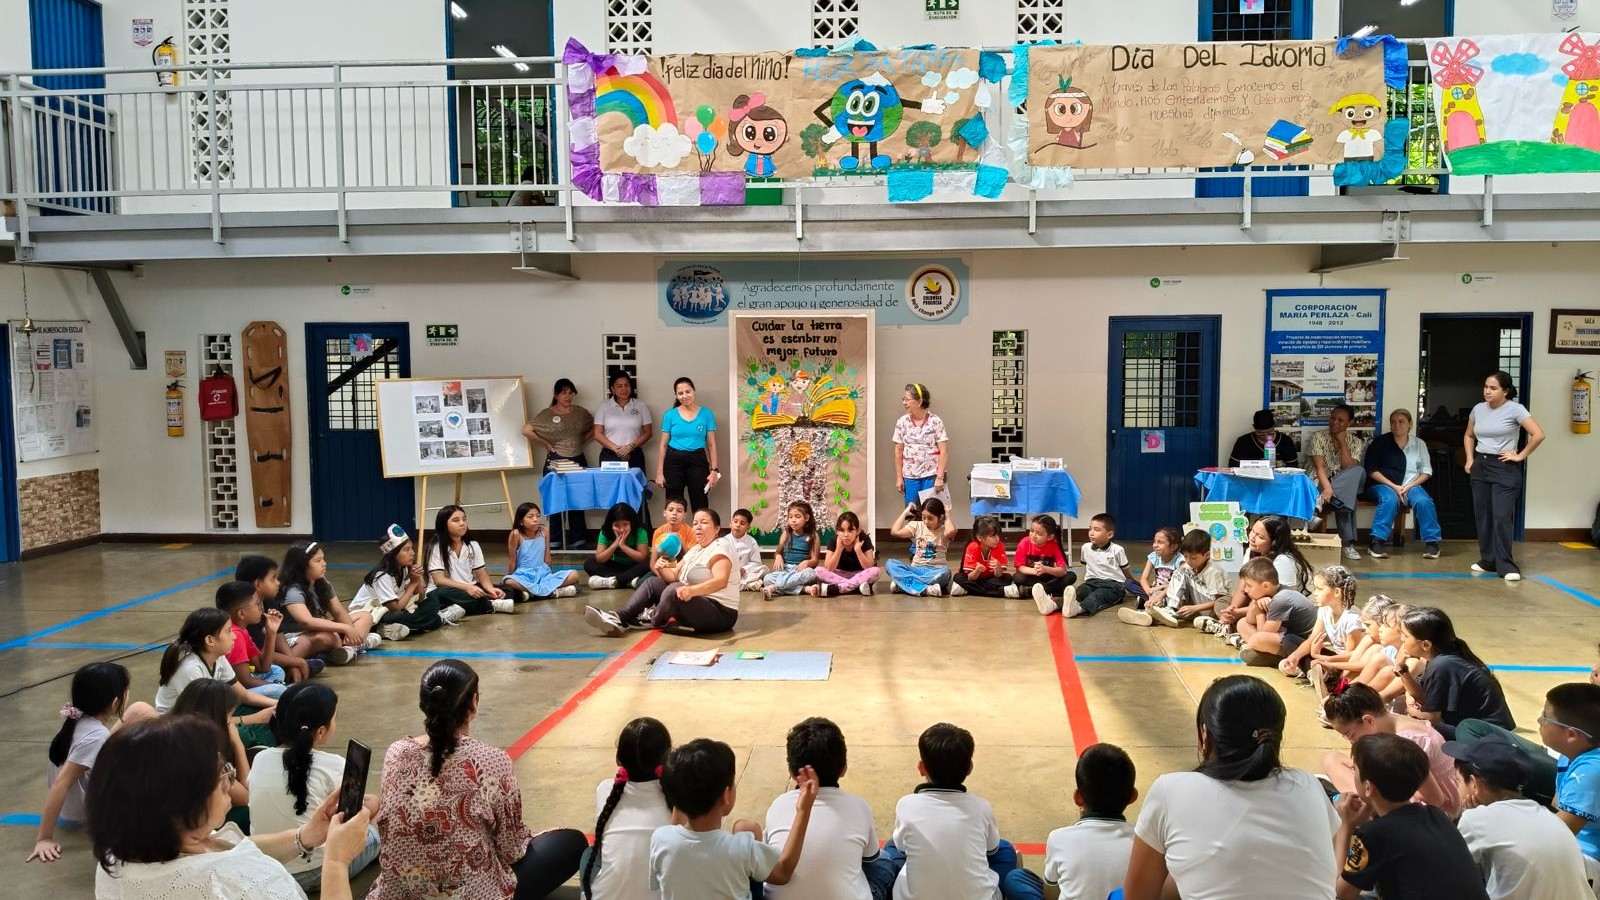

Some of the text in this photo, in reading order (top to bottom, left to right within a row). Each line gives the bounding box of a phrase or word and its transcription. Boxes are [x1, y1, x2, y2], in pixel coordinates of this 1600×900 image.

[741, 278, 895, 297] Agradecemos profundamente
[737, 296, 746, 308] el
[748, 299, 772, 309] gran
[774, 301, 808, 309] apoyo
[819, 294, 883, 309] generosidad
[885, 294, 899, 308] de
[752, 319, 843, 332] Cuidar la tierra
[356, 337, 369, 351] A
[763, 333, 837, 344] es escribir un
[766, 346, 838, 362] mejor futuro
[1147, 434, 1161, 449] D
